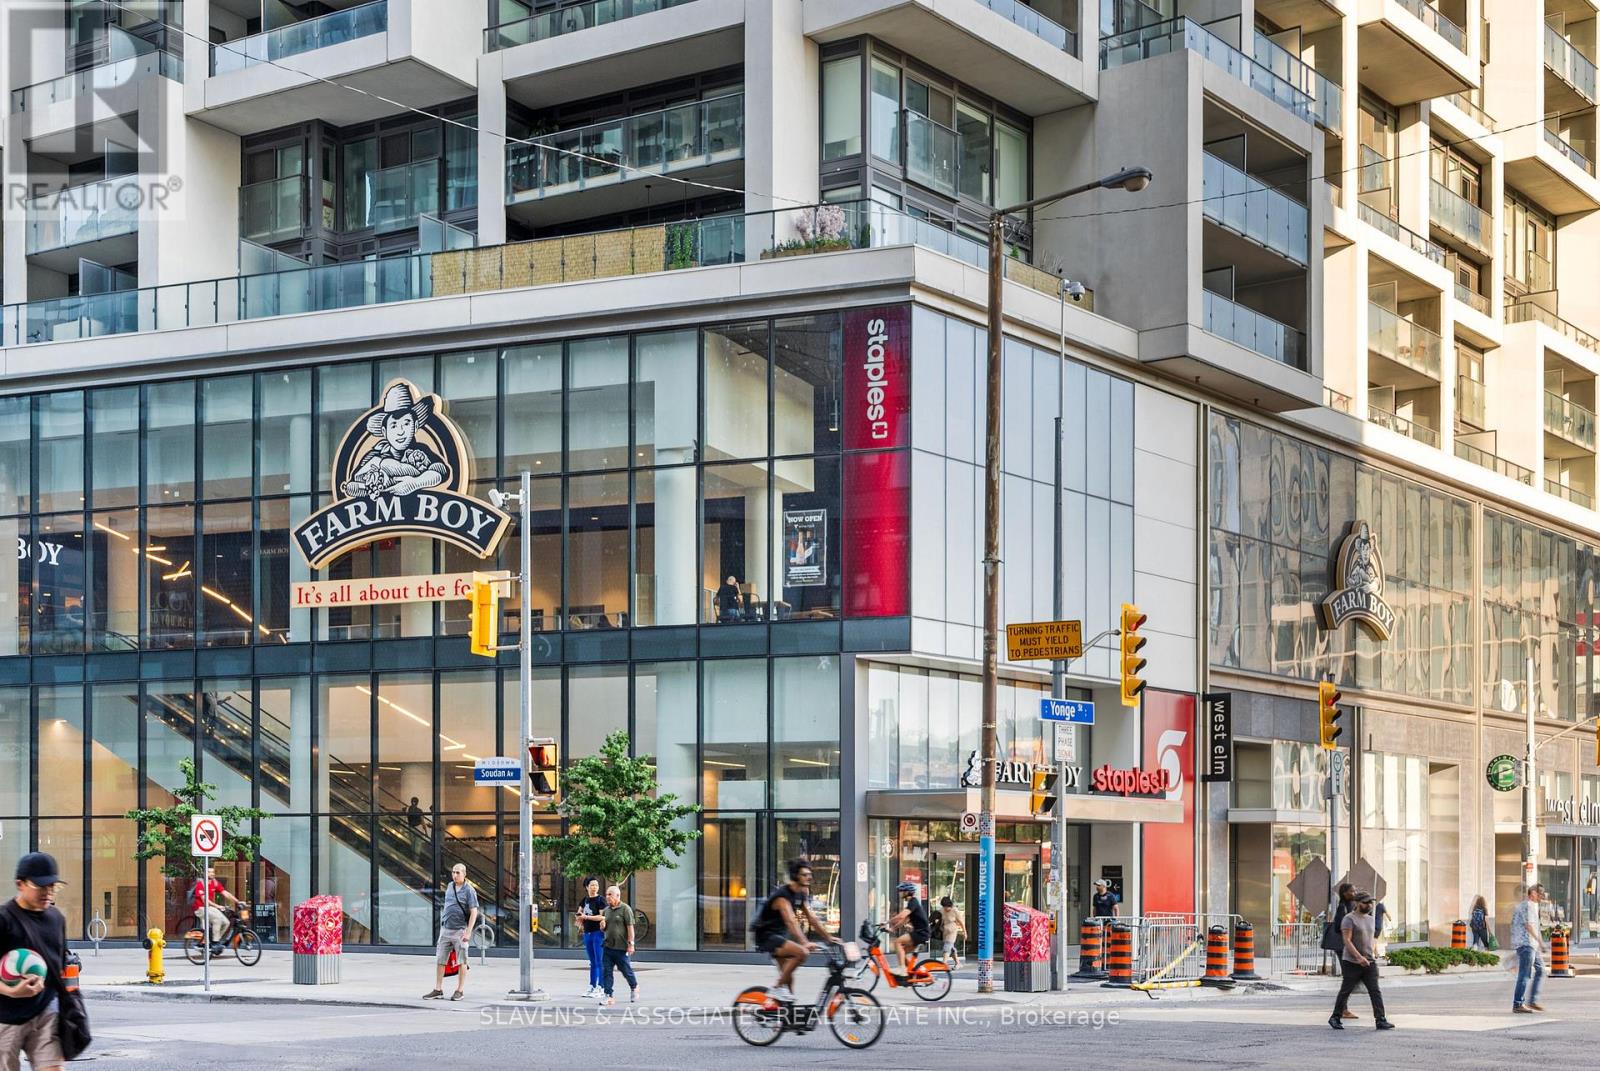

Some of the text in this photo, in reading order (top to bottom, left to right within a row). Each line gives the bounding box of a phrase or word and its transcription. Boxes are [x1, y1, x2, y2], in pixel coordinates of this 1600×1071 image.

[863, 318, 889, 421] staples
[301, 494, 496, 555] FARM BOY
[297, 586, 322, 605] It's
[330, 585, 351, 603] all
[359, 584, 409, 601] about
[417, 580, 446, 598] the
[1333, 591, 1394, 630] FARM BOY
[1009, 623, 1079, 636] TURNING TRAFFIC
[1019, 635, 1069, 646] MUST YIELD
[1010, 645, 1080, 658] TO PEDESTRIANS
[1050, 701, 1076, 720] Yonge
[1213, 700, 1228, 775] west elm
[481, 768, 506, 778] Soudan
[1094, 764, 1160, 797] staples
[1545, 795, 1577, 825] west
[978, 861, 988, 950] MIDTOWN YONGE
